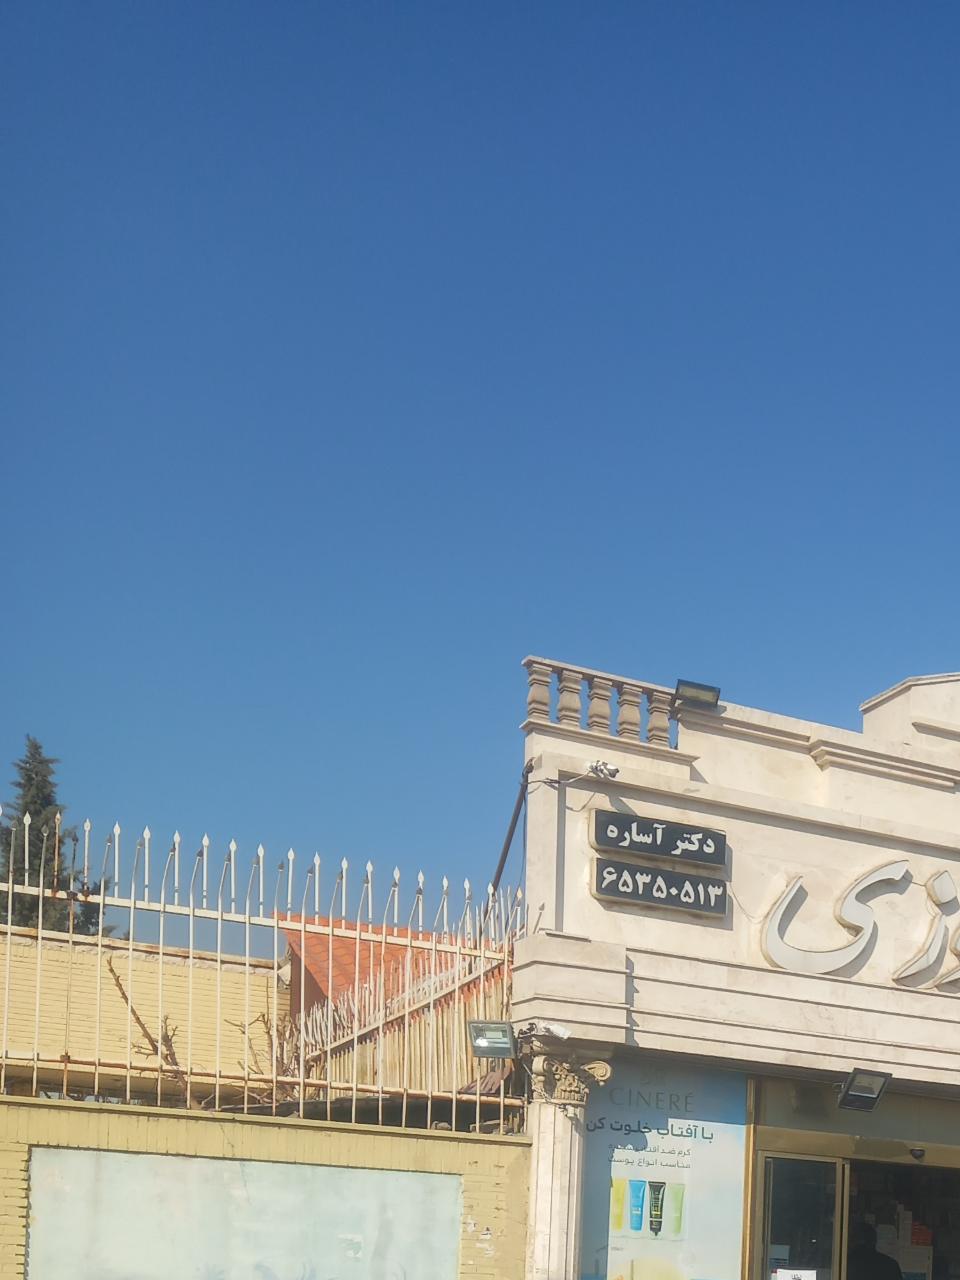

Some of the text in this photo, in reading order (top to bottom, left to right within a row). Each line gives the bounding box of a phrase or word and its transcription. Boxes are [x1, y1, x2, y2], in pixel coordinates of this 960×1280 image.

[606, 822, 715, 855] دکتر آساره
[600, 867, 724, 907] ۶۵۳۵۰۵۱۳
[585, 1117, 714, 1143] با آفتاب خلوت کن
